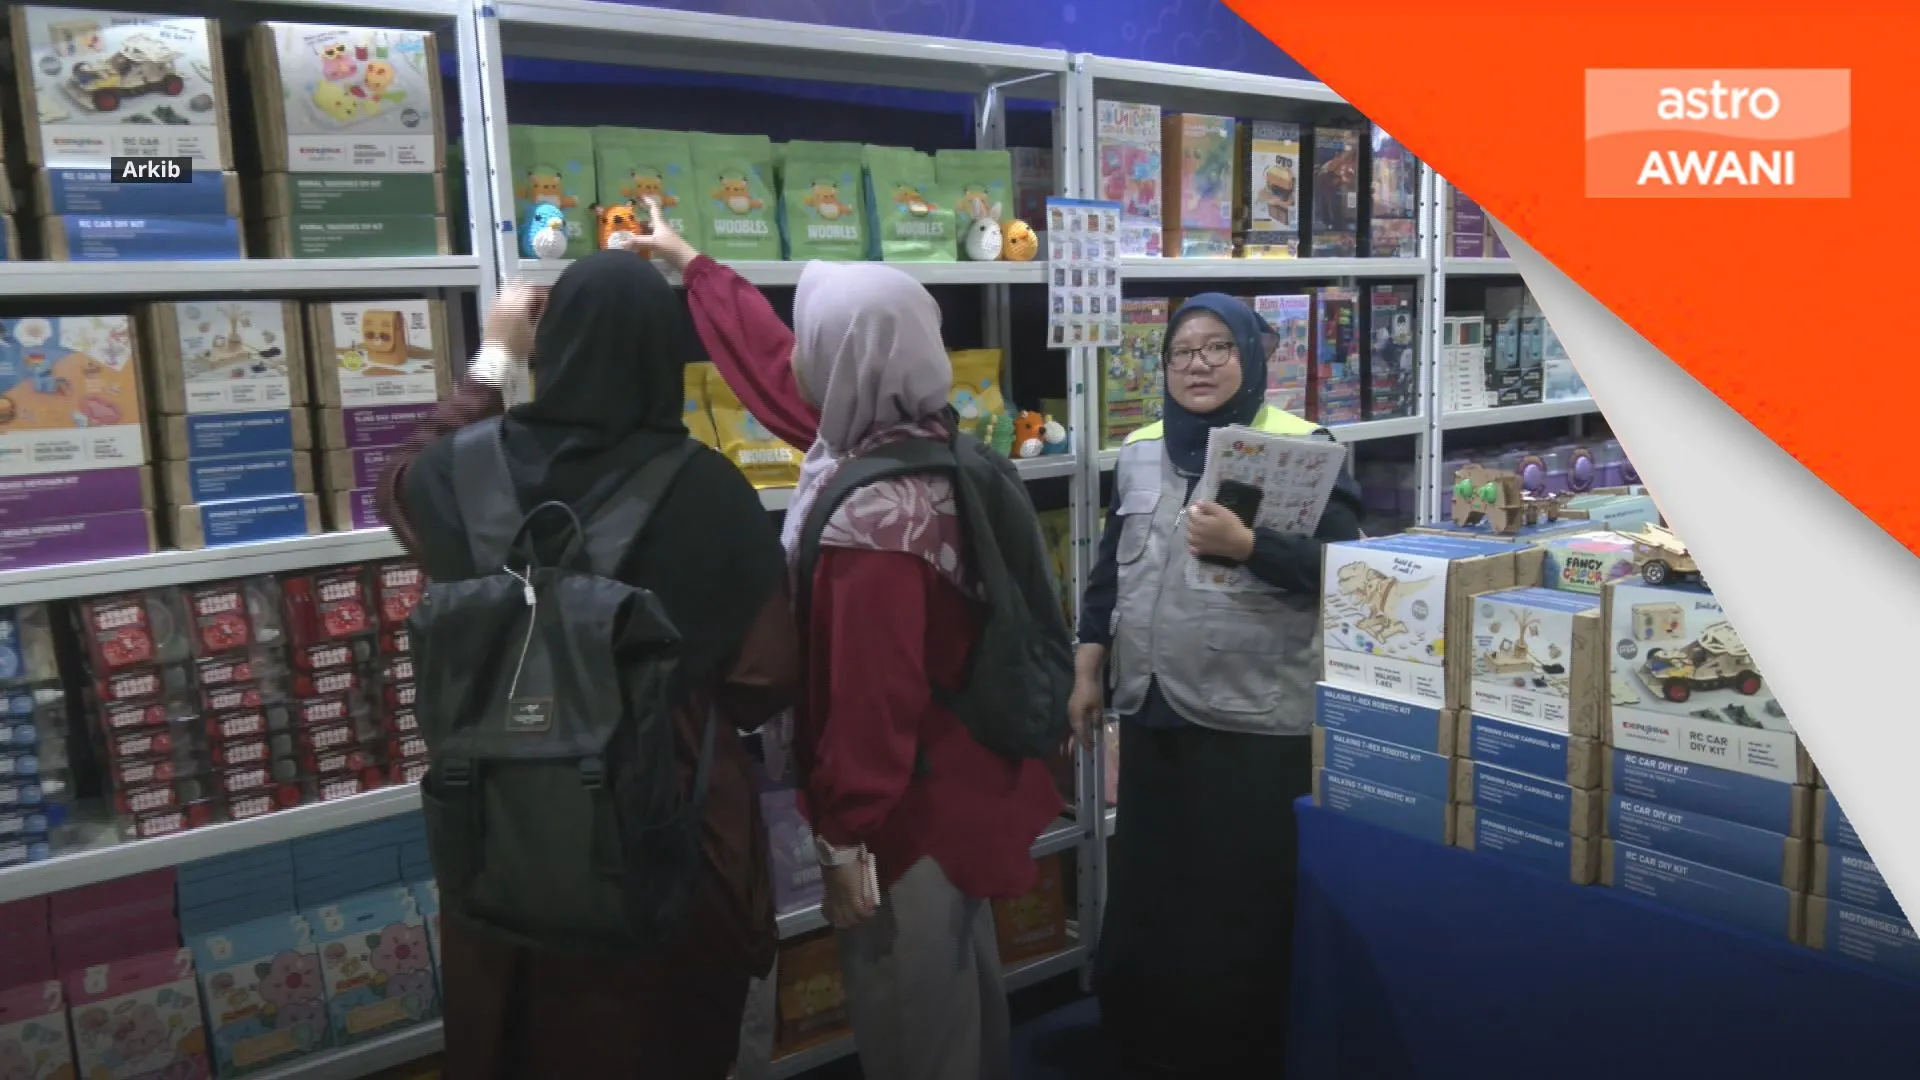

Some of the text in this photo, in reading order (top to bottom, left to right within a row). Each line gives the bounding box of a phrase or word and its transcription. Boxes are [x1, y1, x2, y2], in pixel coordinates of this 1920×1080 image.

[714, 219, 769, 234] WOOBLES
[808, 225, 858, 239] WOOBLES
[897, 221, 943, 236] WOOBLES
[738, 449, 793, 464] WOOBLES
[1566, 557, 1603, 570] FANCY
[1324, 690, 1412, 715] WALKING T-REX ROBOTIC KIT
[1689, 731, 1729, 747] RC CAR
[1333, 734, 1360, 747] WALKING
[1410, 754, 1421, 762] KIT
[1690, 743, 1726, 757] DIY KIT
[1624, 754, 1689, 775] RC CAR DIY KIT
[1328, 775, 1356, 789] WALKING
[1357, 782, 1376, 793] T-REX
[1405, 795, 1416, 805] KIT
[1620, 801, 1683, 824] RC CAR DIY KIT
[1625, 850, 1689, 875] RC CAR DIY KIT
[1842, 855, 1878, 872] MOTOR
[1840, 910, 1899, 935] MOTORISED
